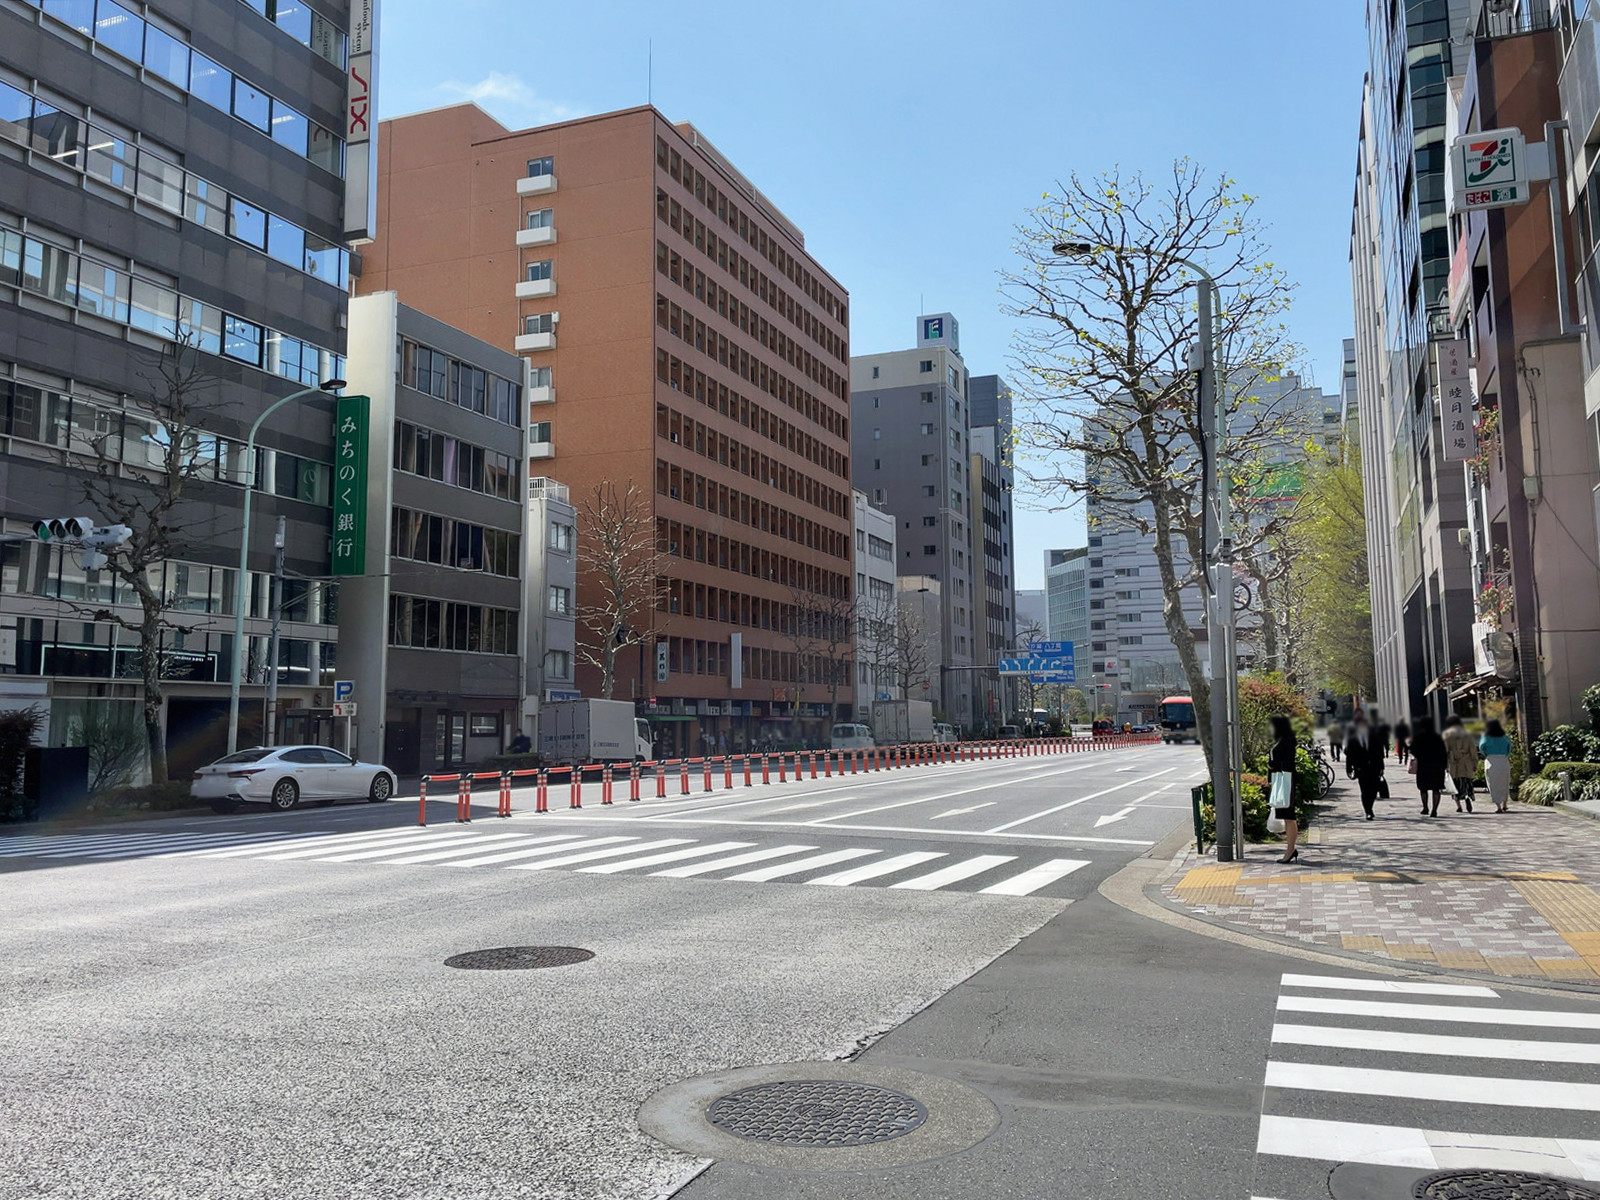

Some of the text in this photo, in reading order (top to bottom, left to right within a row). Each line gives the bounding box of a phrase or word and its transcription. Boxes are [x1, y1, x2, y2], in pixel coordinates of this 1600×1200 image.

[354, 22, 362, 52] system
[350, 67, 368, 134] SIX
[1467, 188, 1511, 205] たばこ 酒
[1448, 387, 1466, 449] 睦月酒場
[336, 416, 357, 558] みちのく銀行
[336, 682, 353, 700] P
